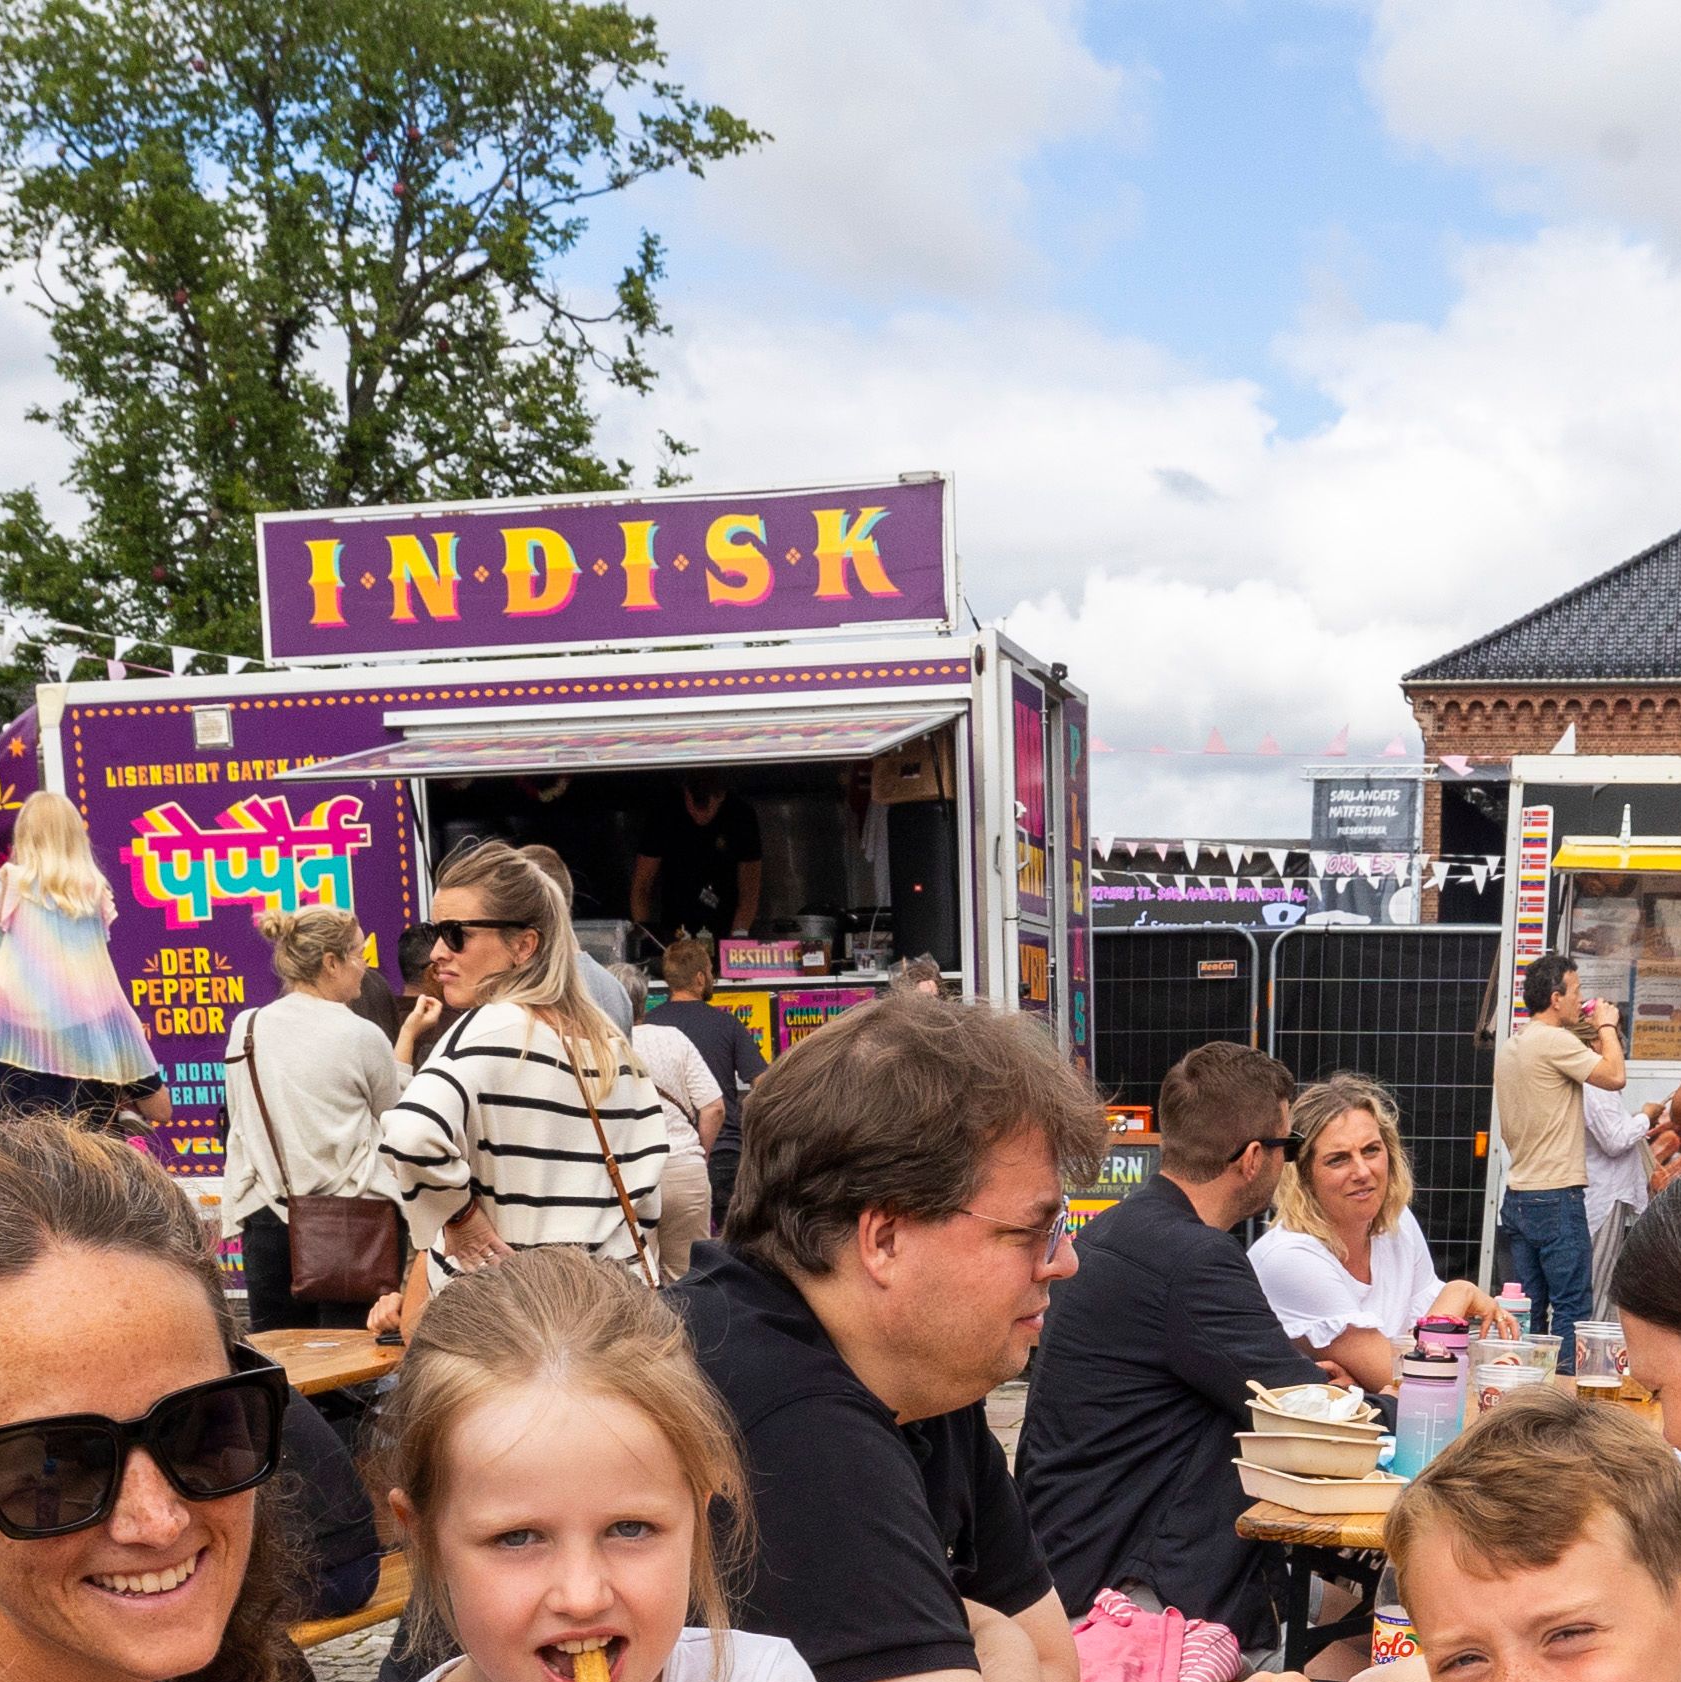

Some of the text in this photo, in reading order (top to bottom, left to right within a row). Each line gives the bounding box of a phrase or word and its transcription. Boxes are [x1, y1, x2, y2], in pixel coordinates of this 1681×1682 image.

[105, 762, 220, 788] LISENSIERT
[1329, 789, 1401, 803] SØRLANDETS
[1328, 805, 1399, 818] MATFESTIVAL
[160, 947, 211, 975] DER
[130, 976, 245, 1006] PEPPERN
[155, 1007, 225, 1035] GROR
